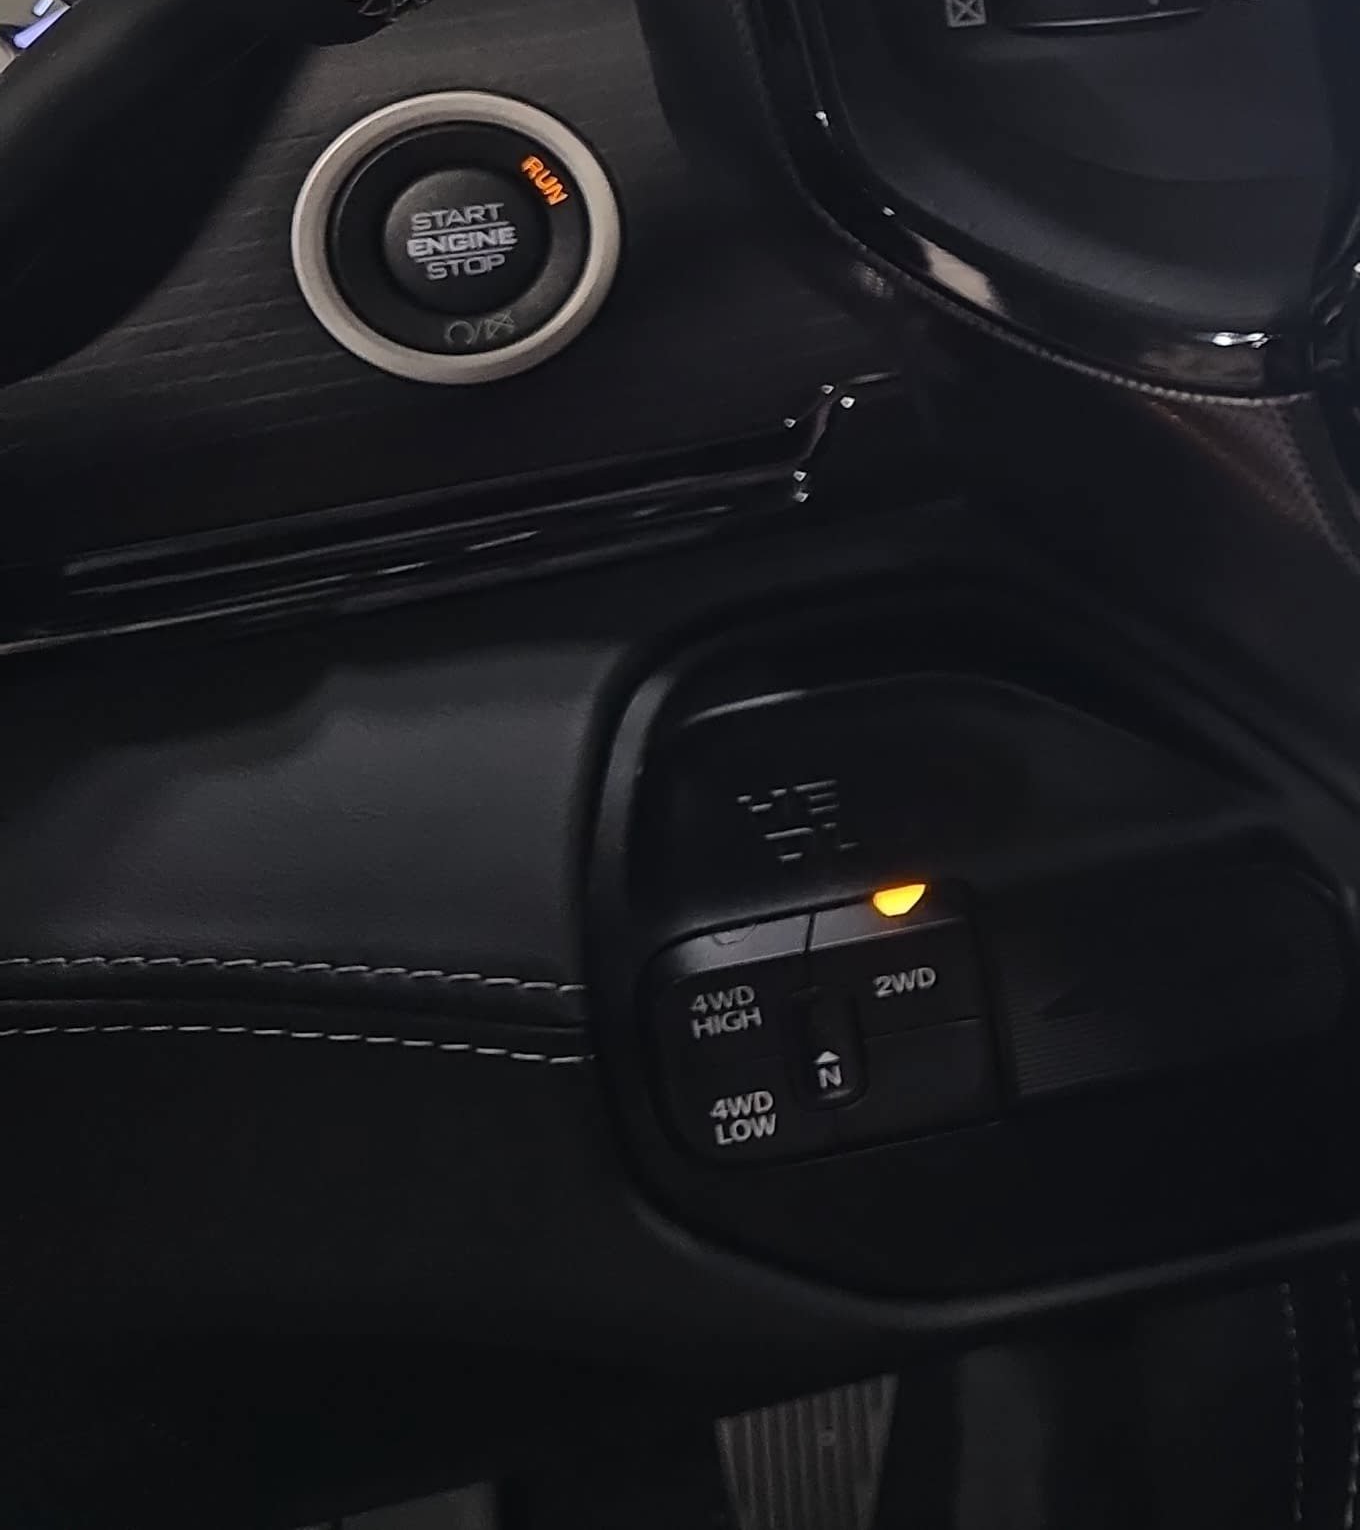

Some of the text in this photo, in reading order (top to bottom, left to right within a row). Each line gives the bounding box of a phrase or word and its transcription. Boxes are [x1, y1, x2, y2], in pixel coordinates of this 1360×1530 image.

[521, 155, 569, 206] RUN
[410, 203, 505, 233] START
[406, 225, 518, 257] ENGINE
[426, 253, 506, 281] STOP
[872, 966, 937, 999] 2WD
[690, 985, 756, 1015] 4WD
[692, 1006, 762, 1040] HIGH
[816, 1064, 843, 1089] N
[710, 1089, 774, 1121] 4WD
[714, 1113, 777, 1146] LOW
